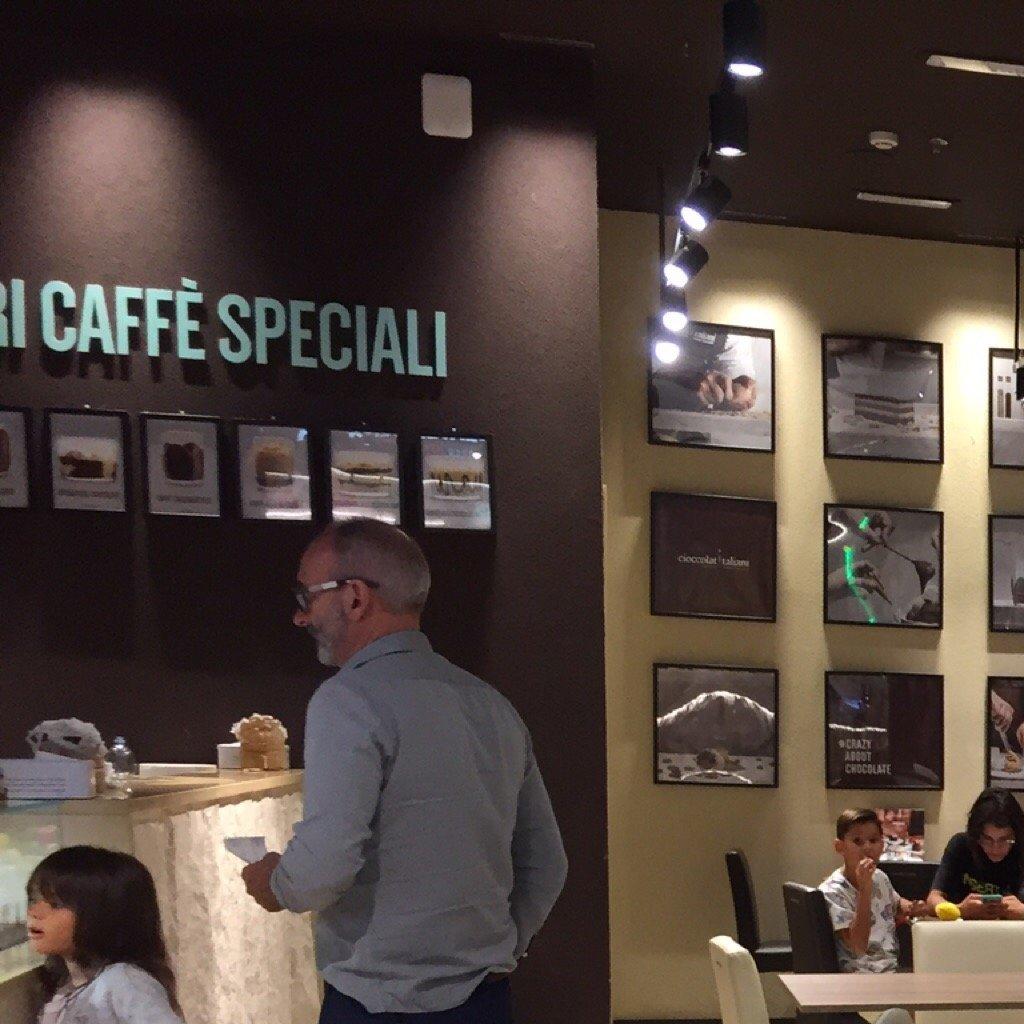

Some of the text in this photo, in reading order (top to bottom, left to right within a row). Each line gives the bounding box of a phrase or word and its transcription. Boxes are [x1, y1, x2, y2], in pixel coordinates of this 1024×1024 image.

[40, 276, 206, 361] CAFFÈ
[217, 292, 449, 378] SPECIALI
[845, 751, 872, 762] ABOUT
[845, 763, 892, 775] CHOCOLATE
